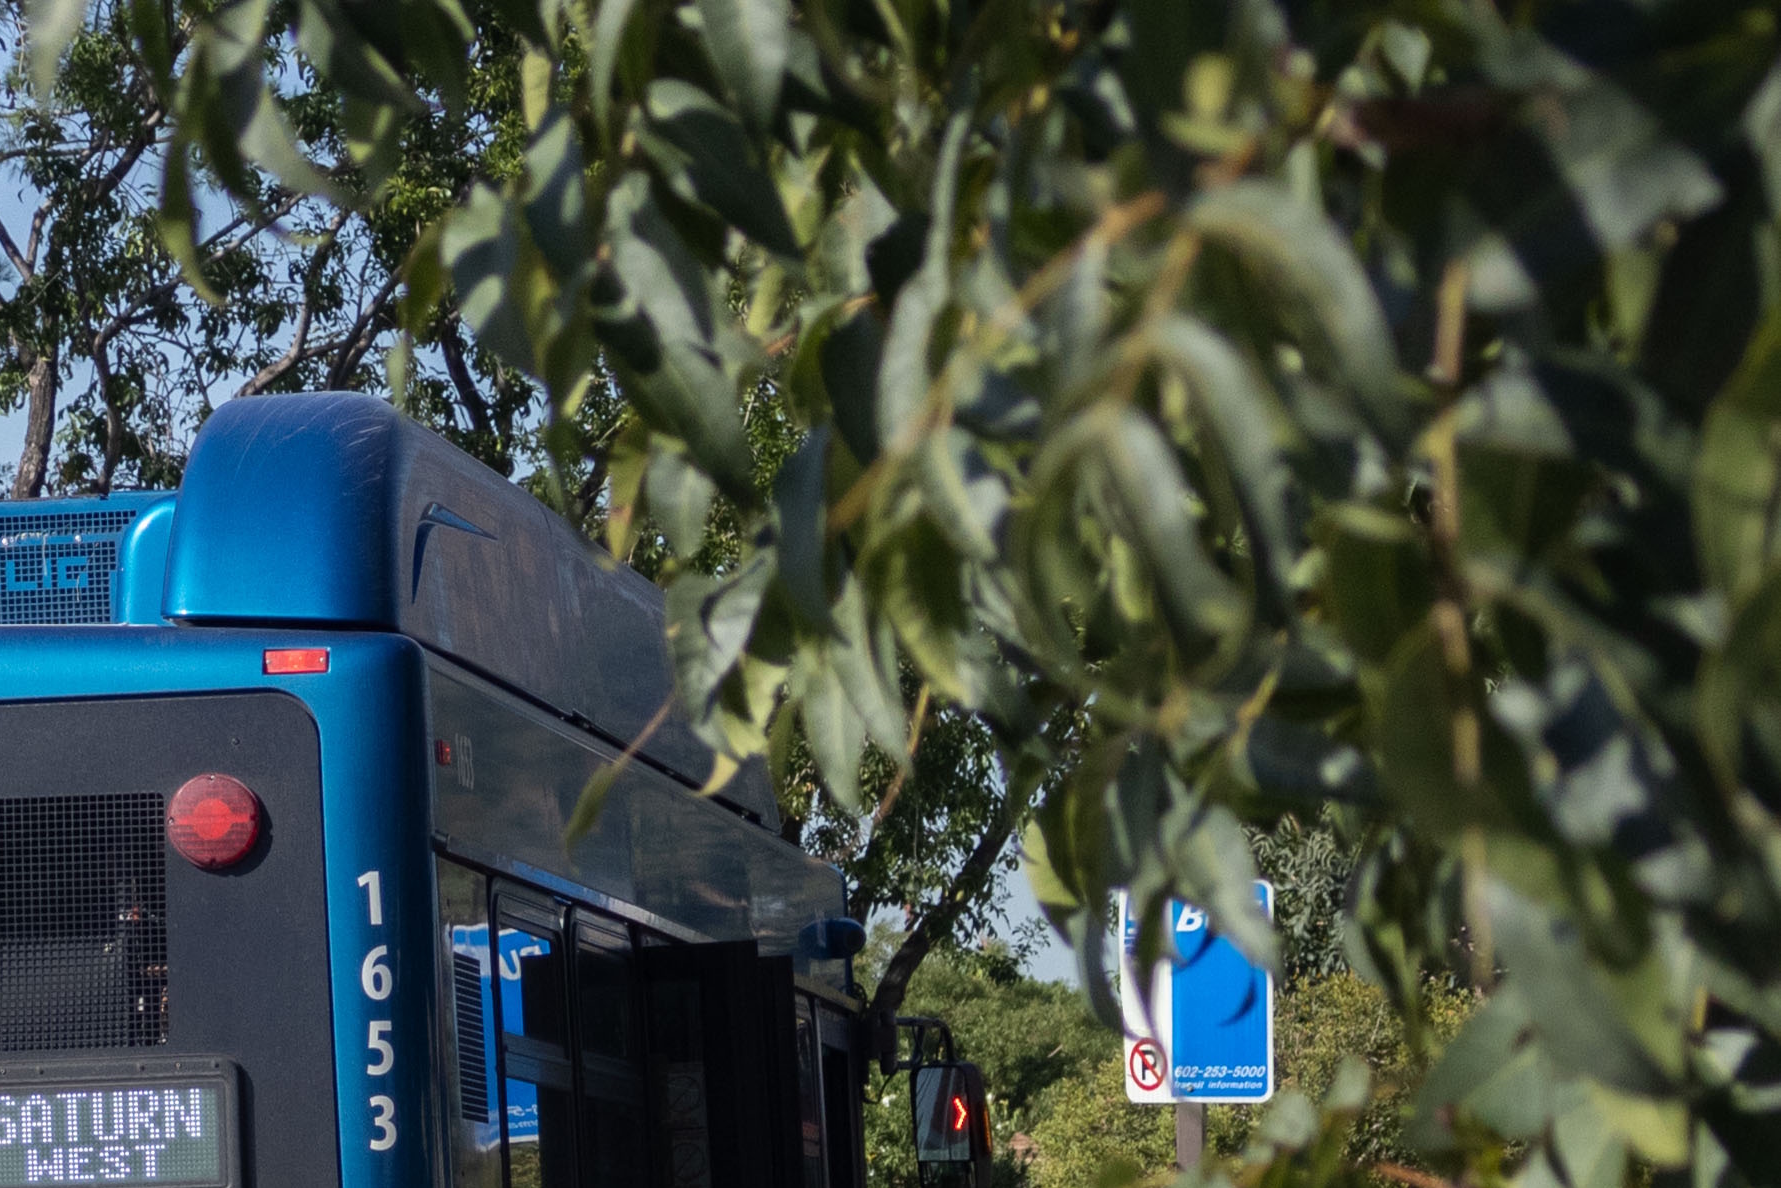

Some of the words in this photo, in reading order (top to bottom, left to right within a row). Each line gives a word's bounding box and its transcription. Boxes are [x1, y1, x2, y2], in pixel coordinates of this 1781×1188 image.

[356, 870, 398, 1151] 1653
[1174, 1065, 1266, 1079] 602-253-5000
[1207, 1081, 1263, 1090] information
[27, 1144, 165, 1181] WEST
